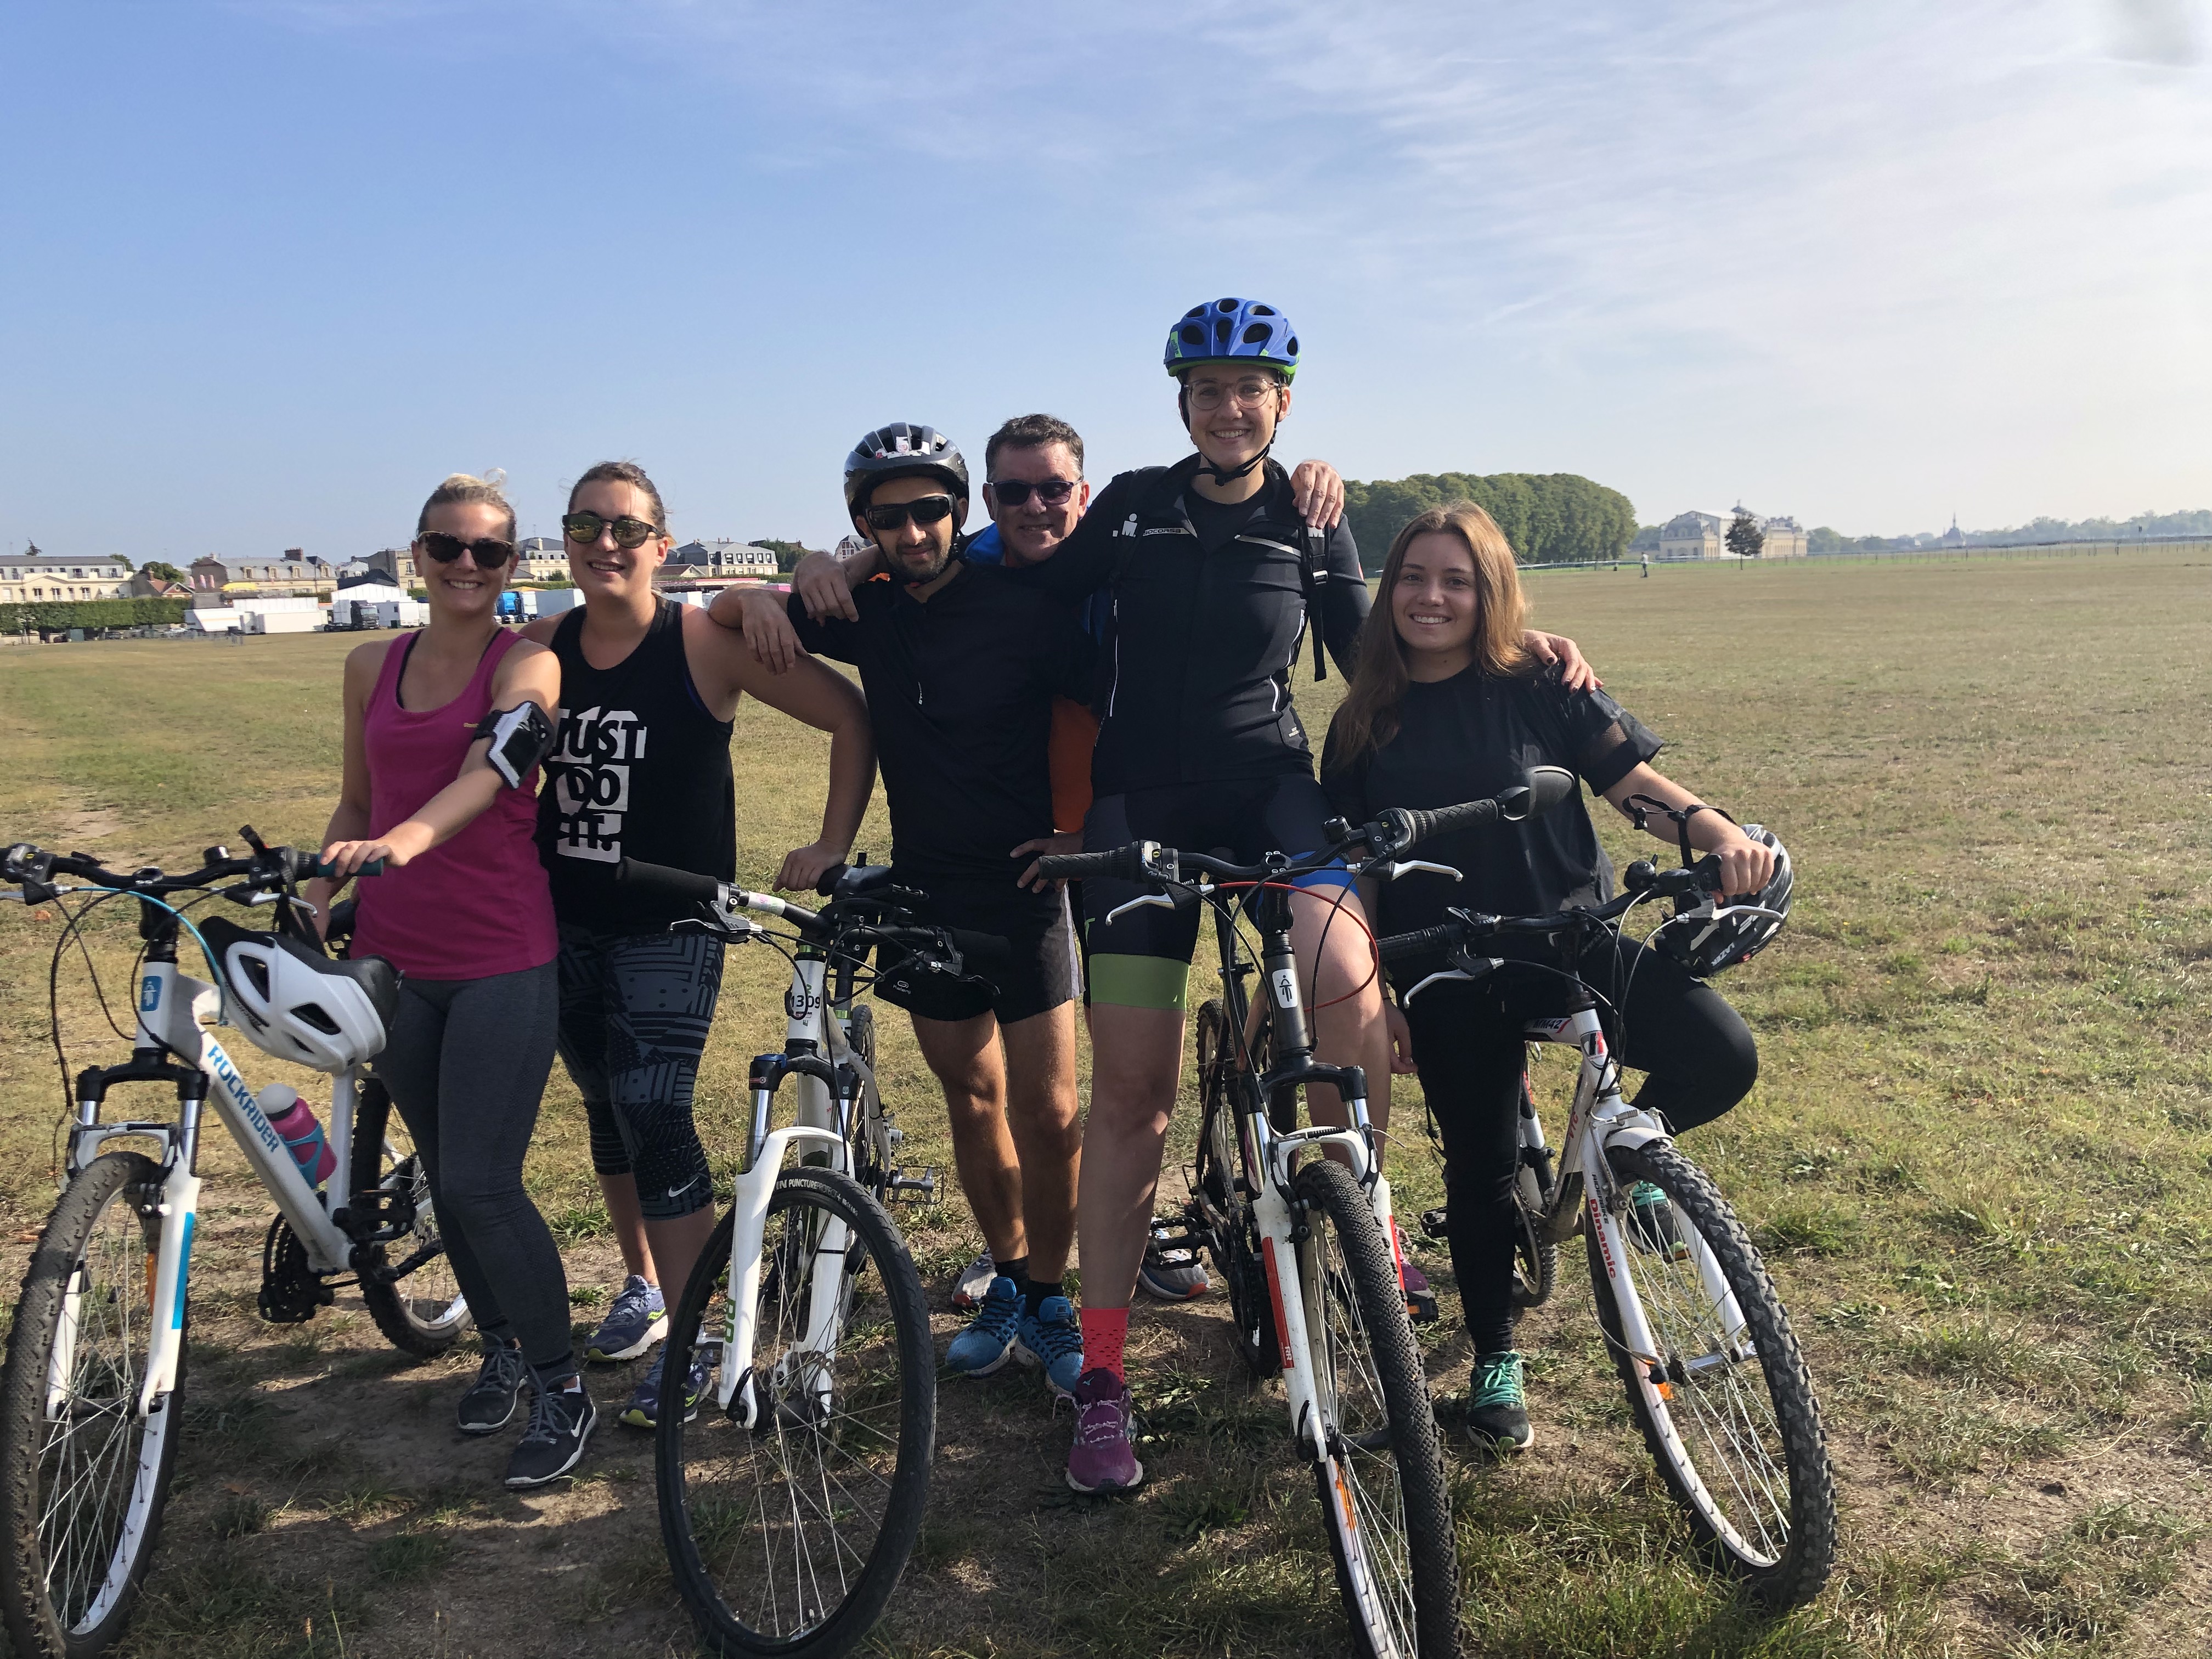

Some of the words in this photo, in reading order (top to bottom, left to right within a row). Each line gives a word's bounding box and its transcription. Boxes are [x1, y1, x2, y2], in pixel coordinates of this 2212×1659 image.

[551, 710, 647, 763] JUST
[560, 767, 625, 810] DO
[791, 995, 821, 1009] 1309
[207, 1045, 280, 1152] ROCKRIDER
[1590, 1198, 1616, 1279] Dinamic
[1284, 1346, 1293, 1361] RR
